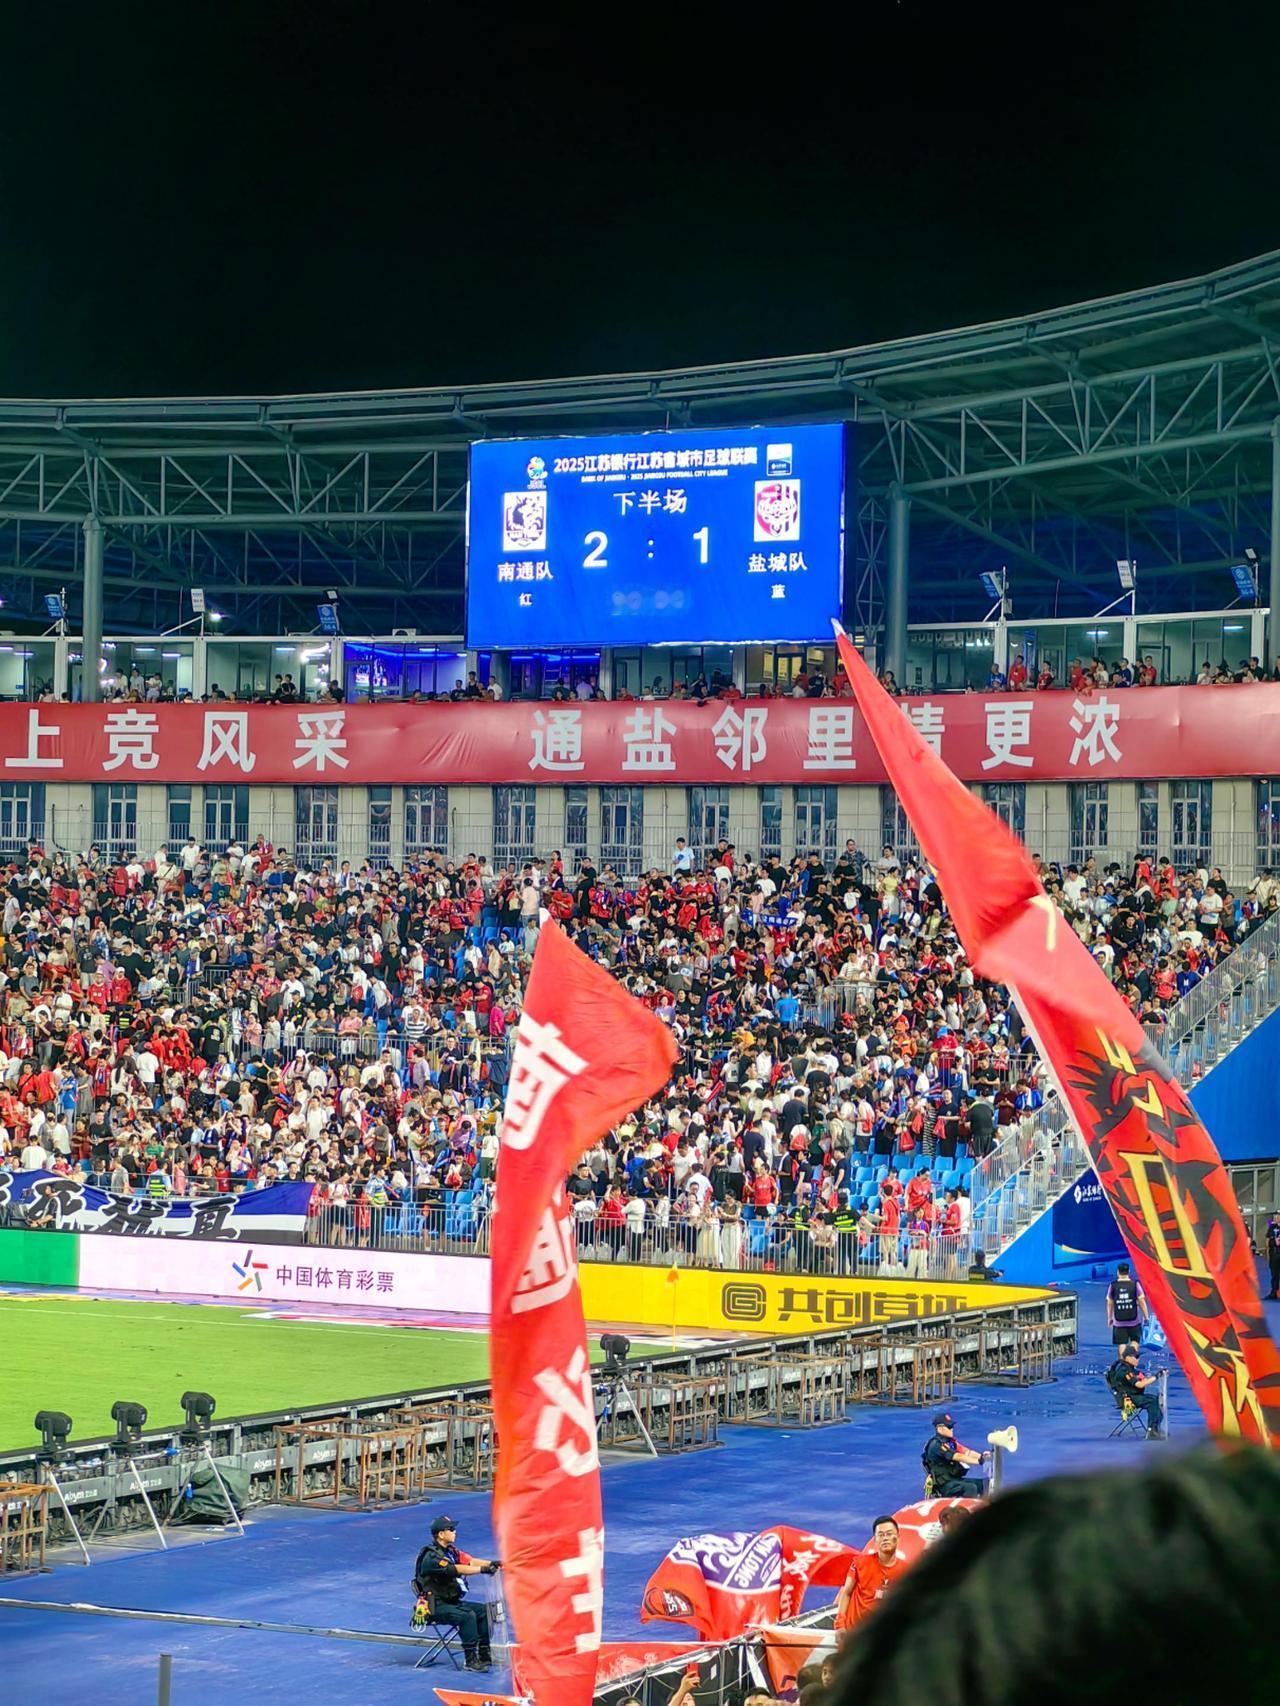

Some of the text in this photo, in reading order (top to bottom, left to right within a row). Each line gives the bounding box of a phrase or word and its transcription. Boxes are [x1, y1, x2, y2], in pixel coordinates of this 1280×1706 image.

[613, 489, 688, 516] 下半场
[582, 531, 608, 569] 2
[693, 526, 709, 564] 1
[497, 561, 554, 582] 南通队
[748, 552, 808, 573] 盐城队
[519, 593, 533, 606] 红
[771, 584, 786, 599] 蓝
[5, 708, 350, 772] 上竞风采
[276, 1264, 395, 1293] 中国体育彩票
